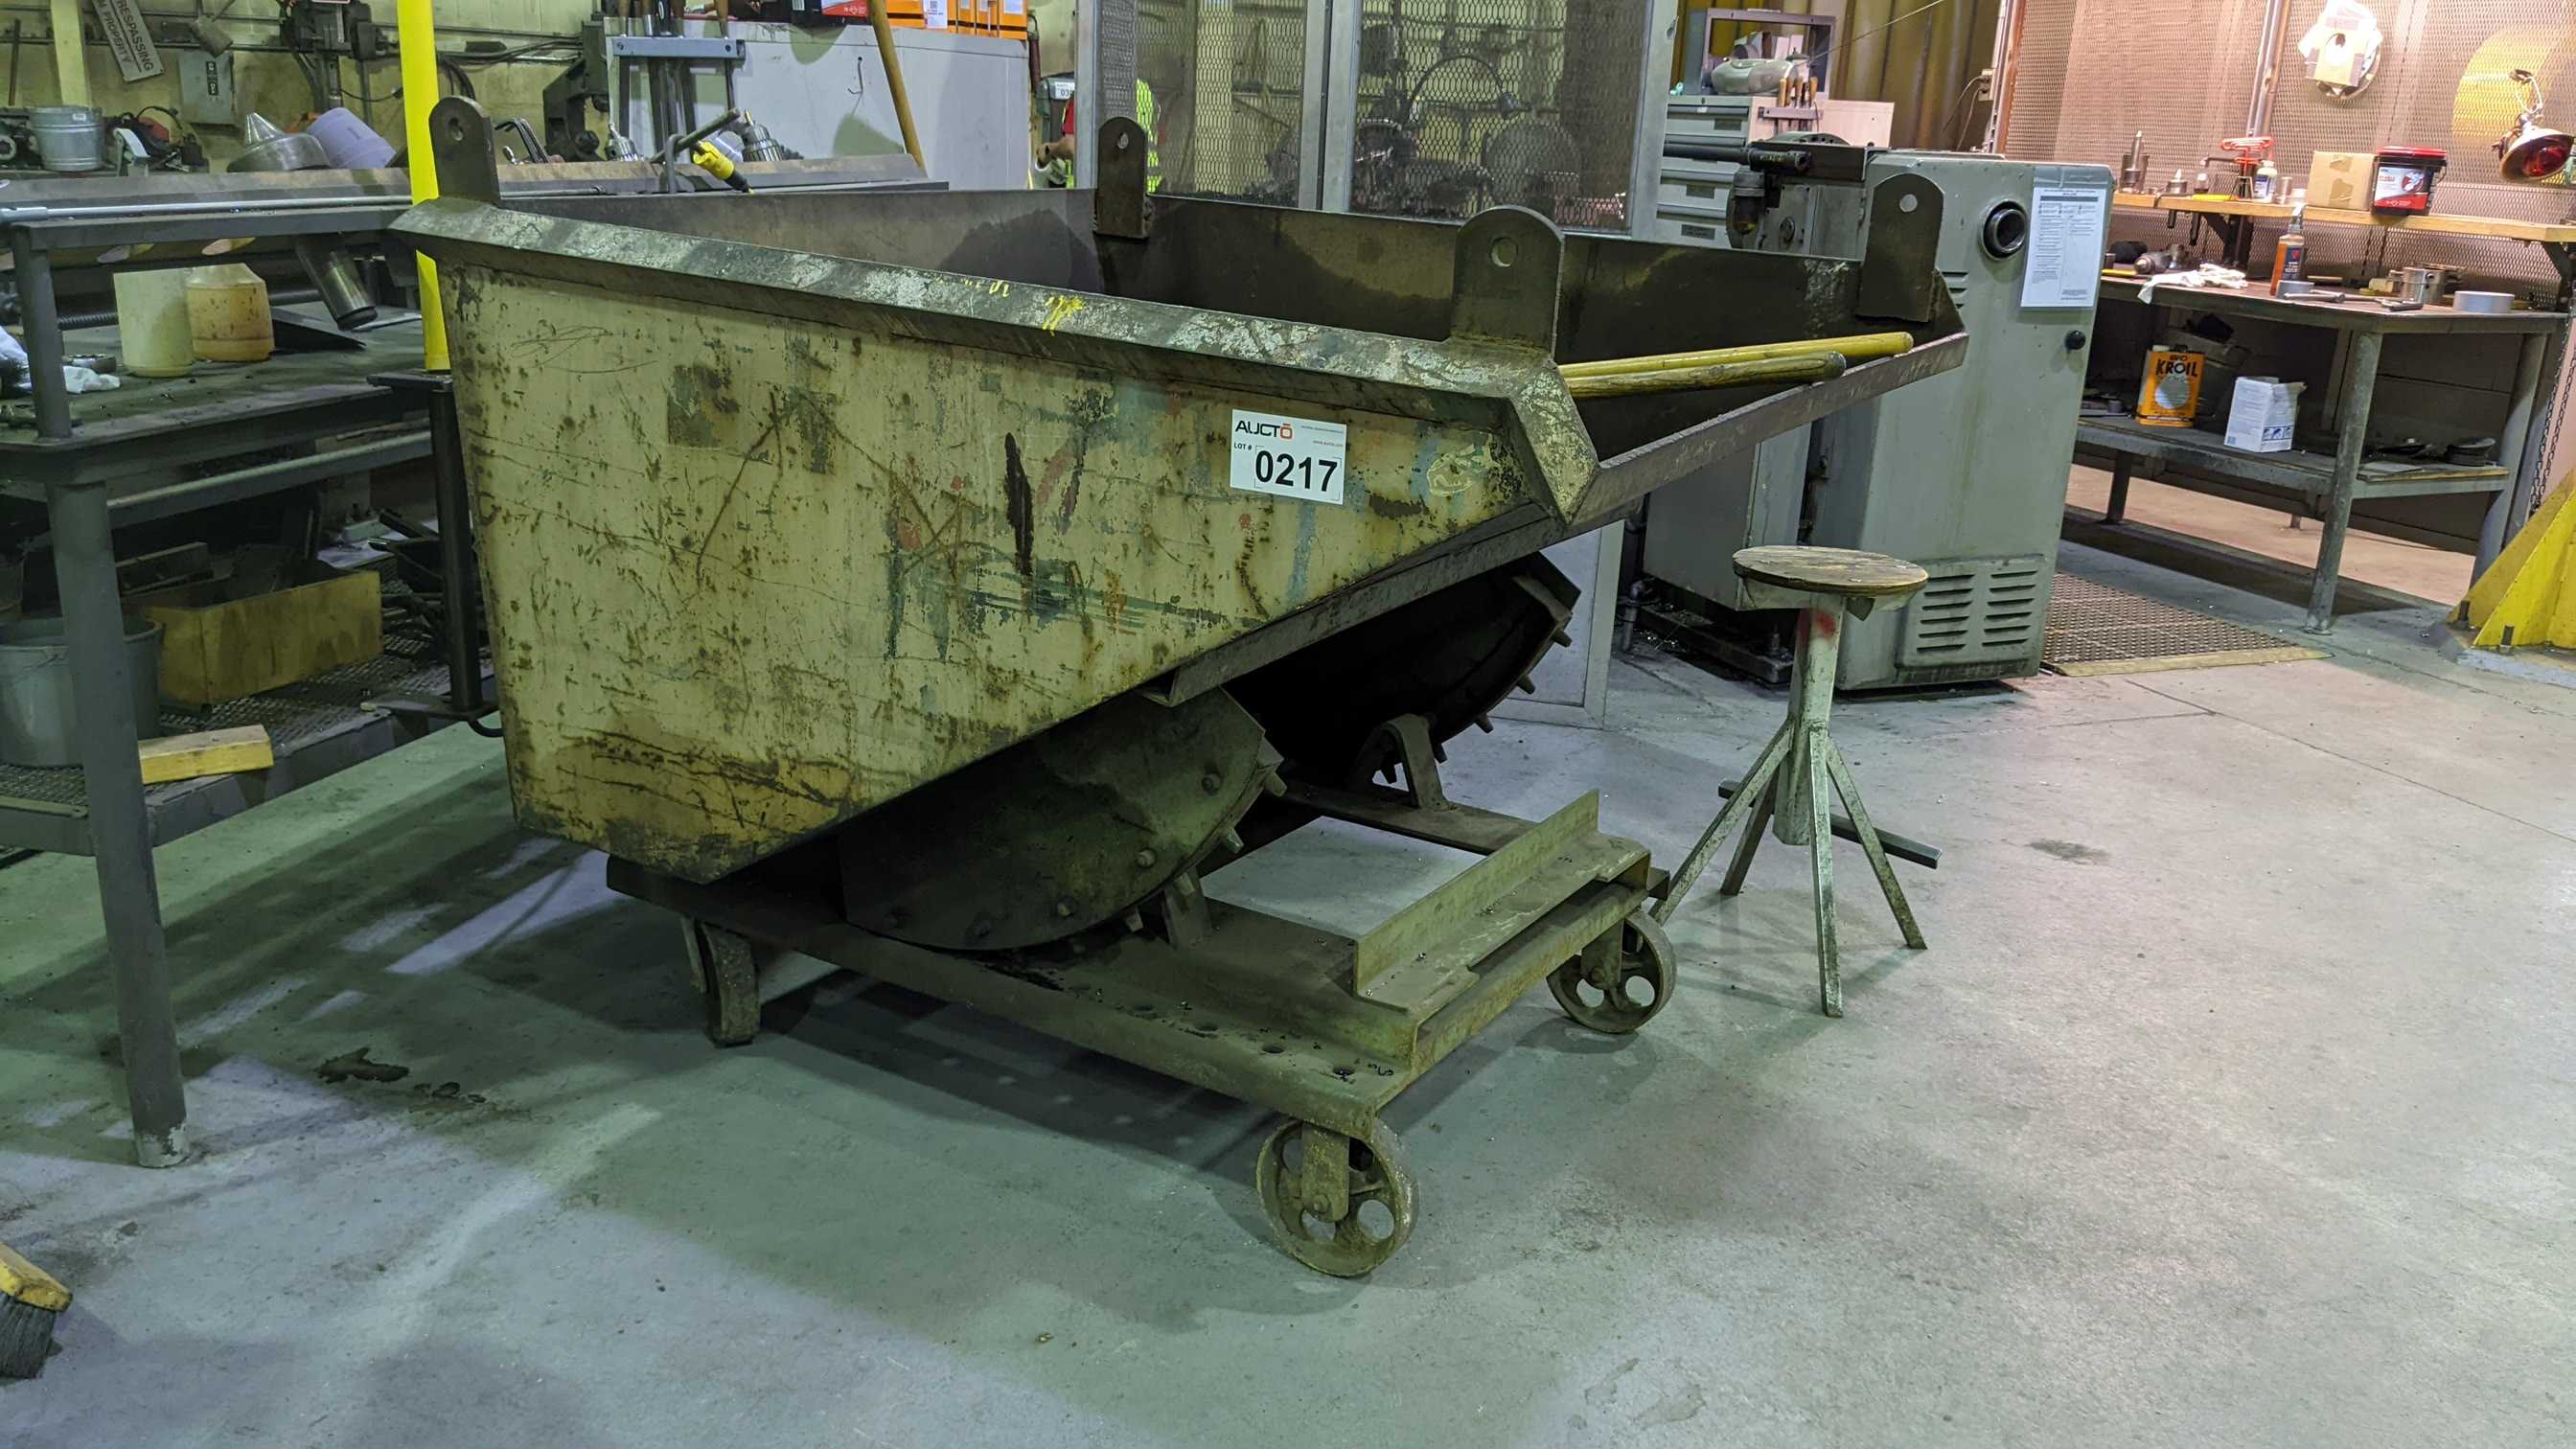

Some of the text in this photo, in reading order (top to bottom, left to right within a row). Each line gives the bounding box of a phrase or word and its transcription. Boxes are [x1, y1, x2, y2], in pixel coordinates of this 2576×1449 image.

[2155, 358, 2197, 377] KROIL
[1233, 442, 1246, 450] LOT
[1255, 450, 1338, 492] 0217
